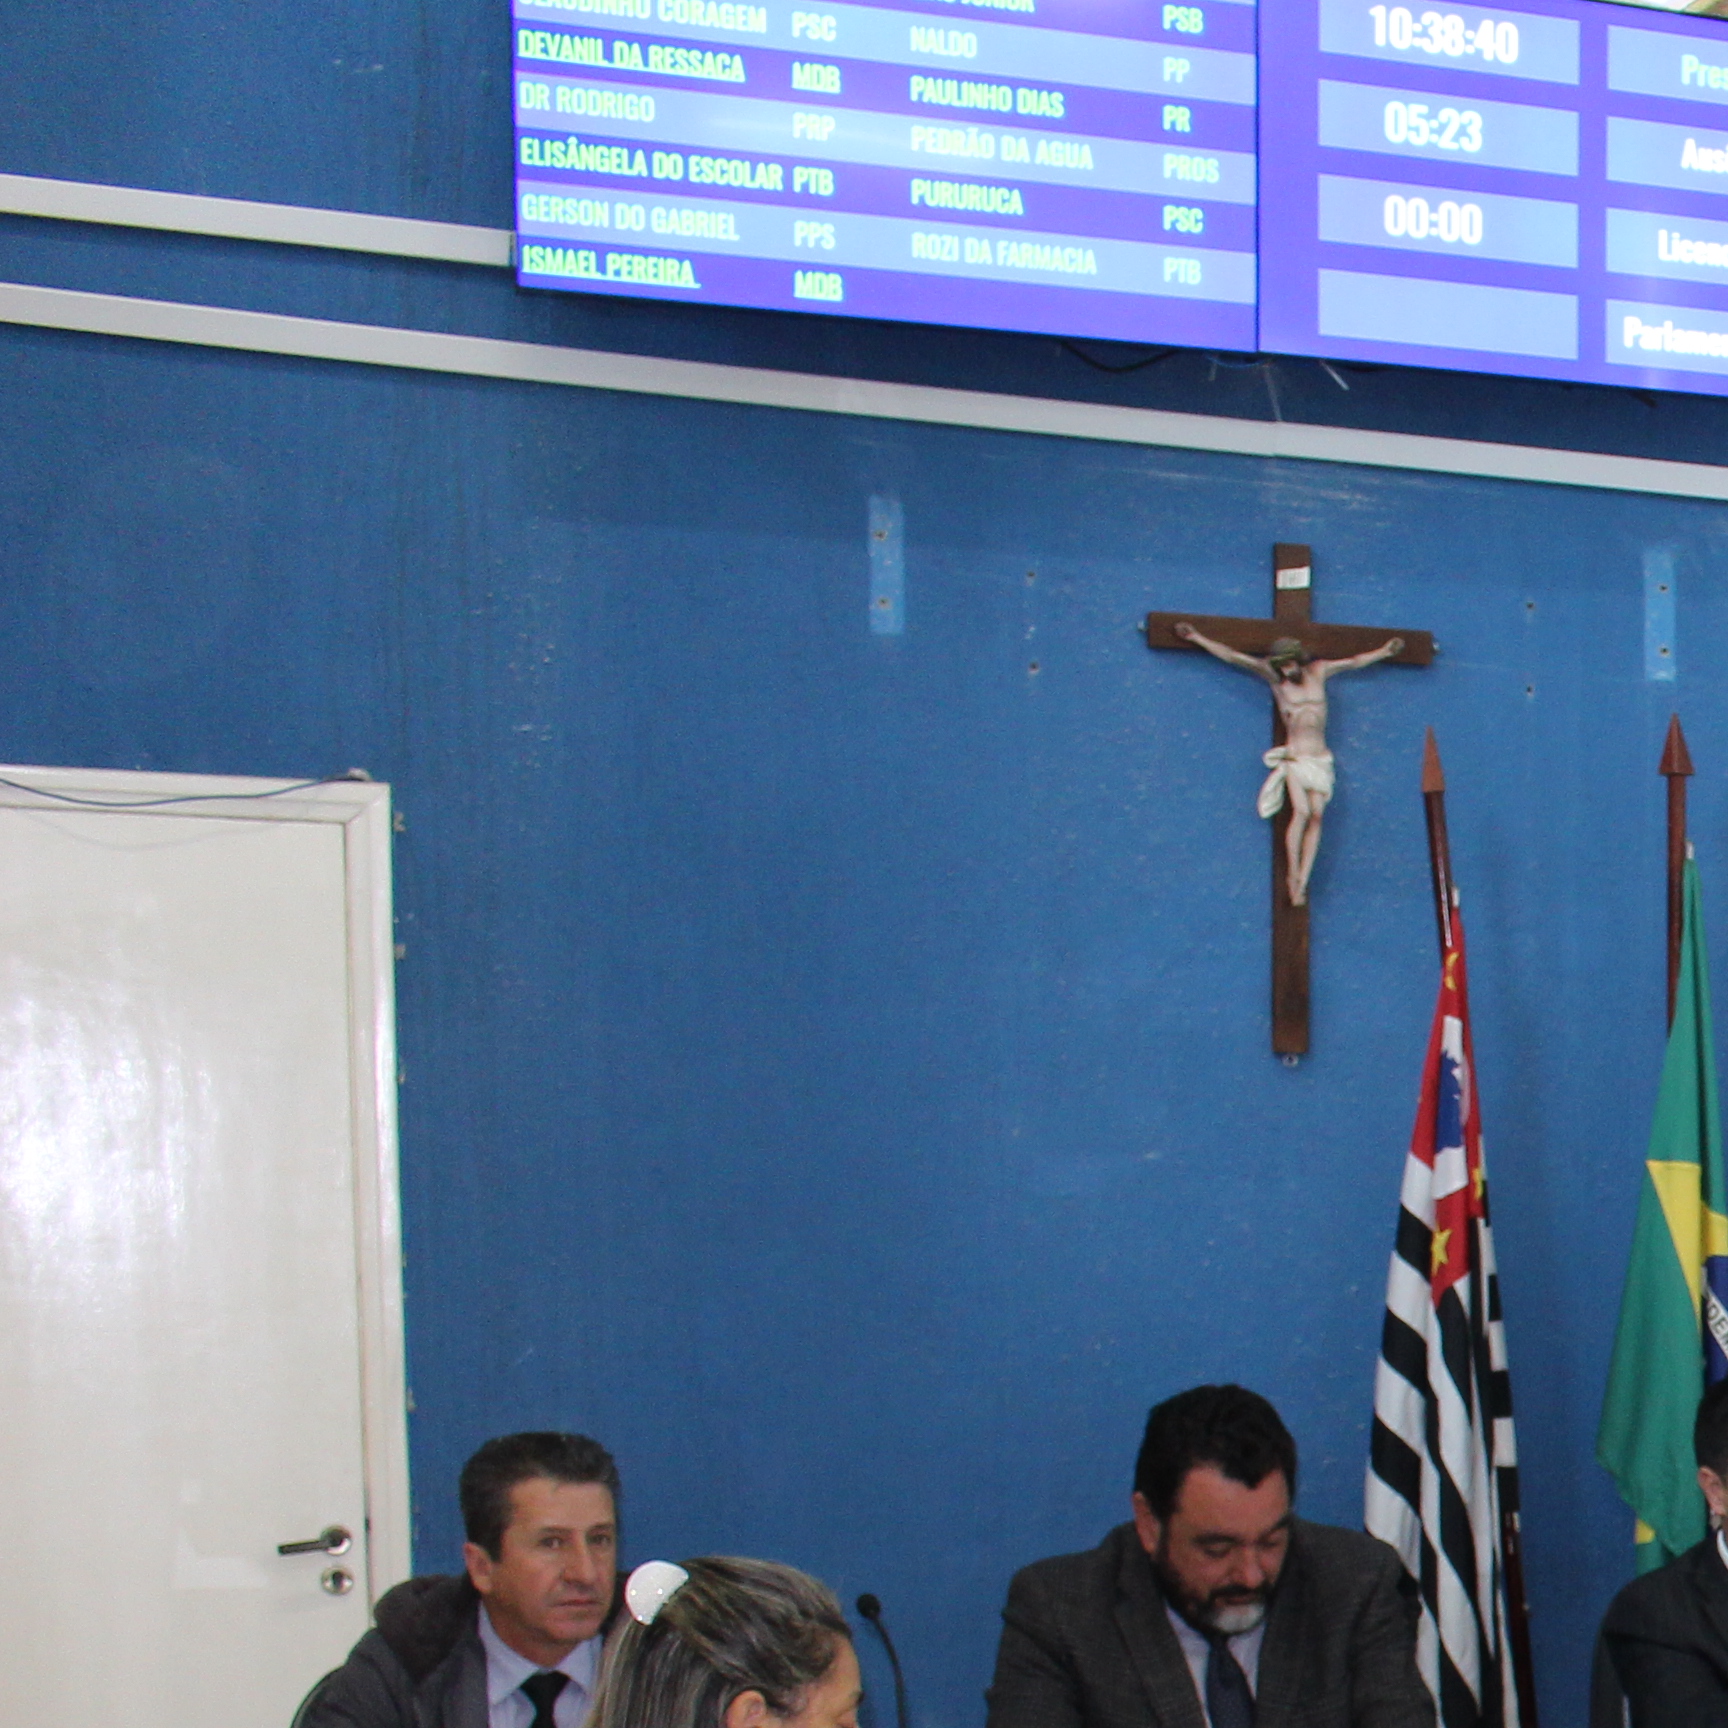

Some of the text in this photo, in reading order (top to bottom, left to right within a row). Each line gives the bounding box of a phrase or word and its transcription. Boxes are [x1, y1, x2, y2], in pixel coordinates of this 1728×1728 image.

[791, 12, 837, 42] PSC
[1163, 4, 1203, 33] PSB
[1369, 5, 1519, 64] 10:38:40
[518, 29, 841, 94] DEVANIL DA RESSACA MDB
[910, 26, 1191, 84] NALDO PP
[519, 82, 836, 142] DR RODRIGO PRP
[910, 75, 1191, 133] PAULINHO DIAS PR
[1384, 101, 1483, 152] 05:23
[519, 136, 835, 197] ELISÂNGELA DO ESCOLAR PTB
[910, 125, 1220, 183] PEDRÃO DA AGUA PROS
[522, 193, 835, 250] GERSON DO GABRIEL PPS
[910, 178, 1203, 234] PURURUCA PSC
[1384, 194, 1483, 245] 00:00
[522, 245, 843, 302] ISMAEL PEREIRA MDB
[911, 232, 1202, 286] ROZI DA FARMACIA PTB
